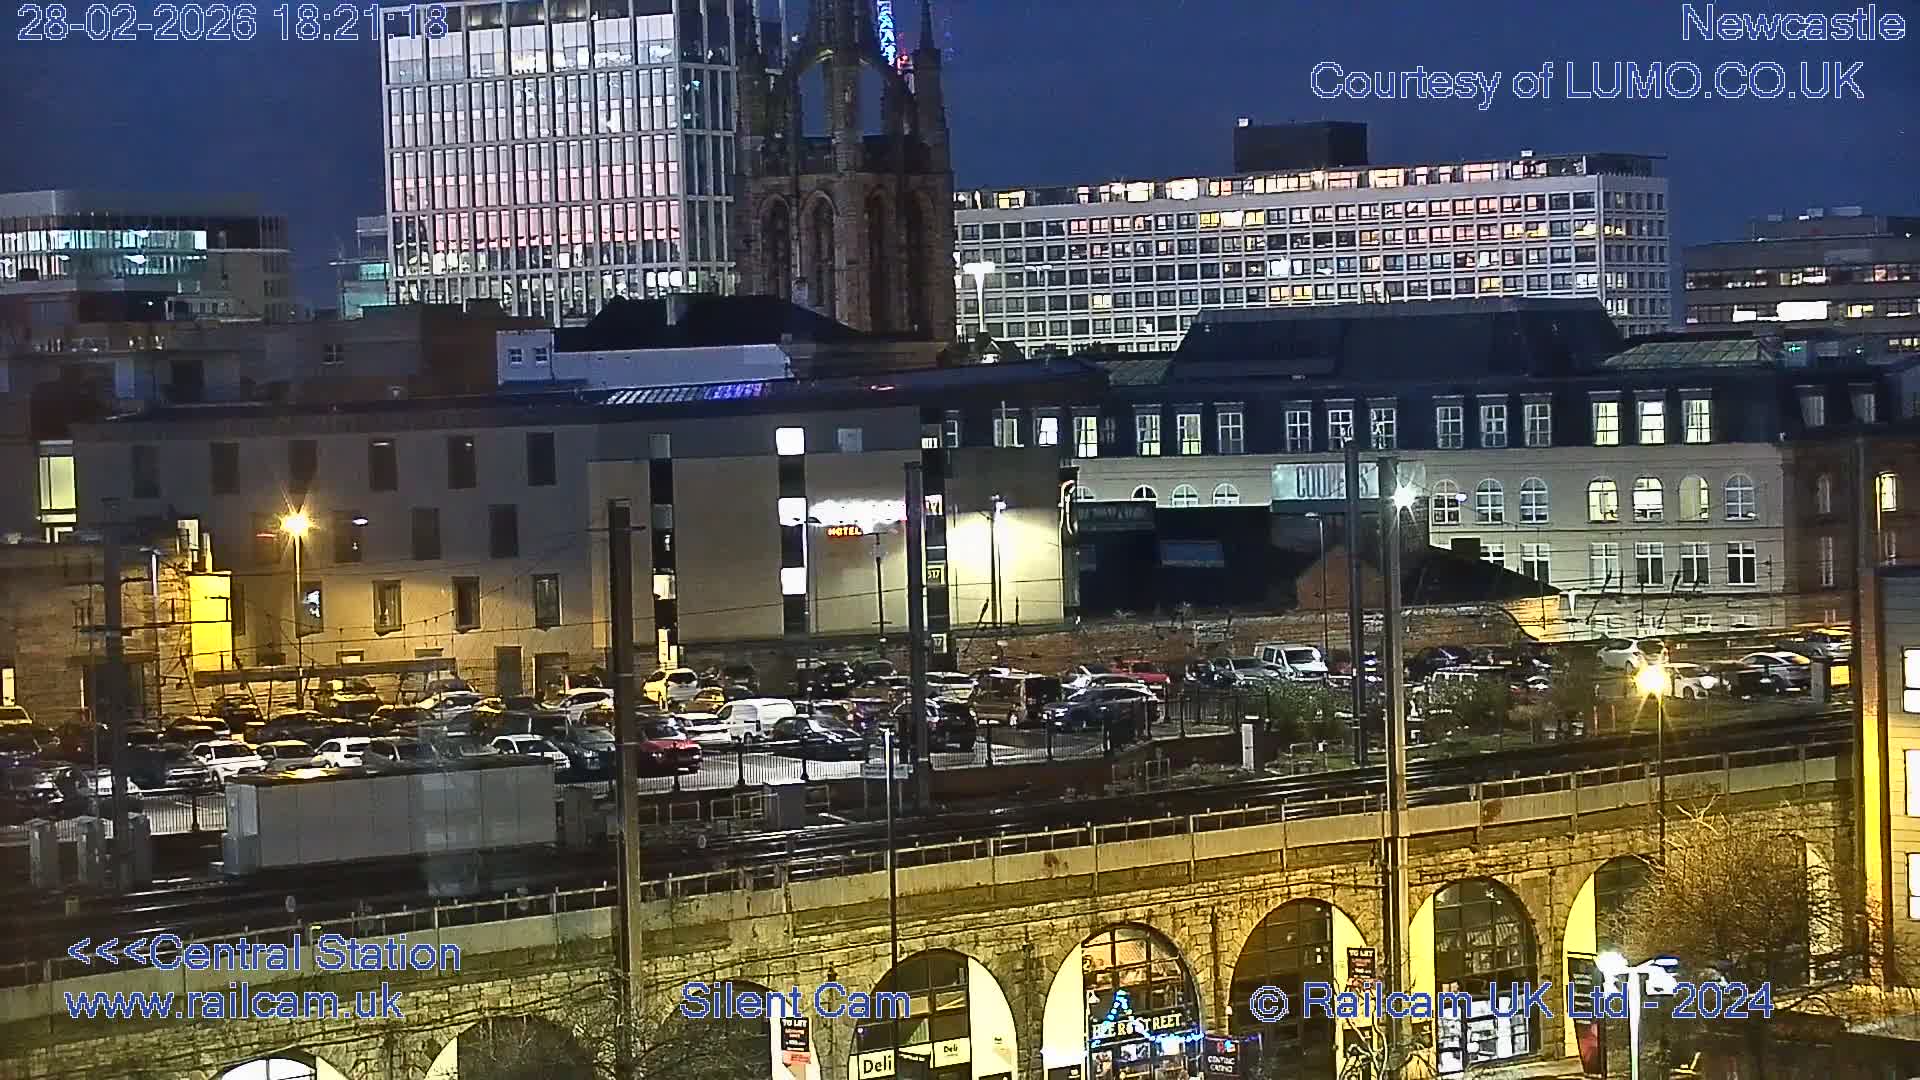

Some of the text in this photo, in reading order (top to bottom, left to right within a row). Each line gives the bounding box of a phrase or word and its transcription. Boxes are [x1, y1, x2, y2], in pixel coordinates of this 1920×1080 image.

[827, 526, 862, 537] HOTEL
[943, 1044, 958, 1053] Deli
[863, 1055, 892, 1074] Deli
